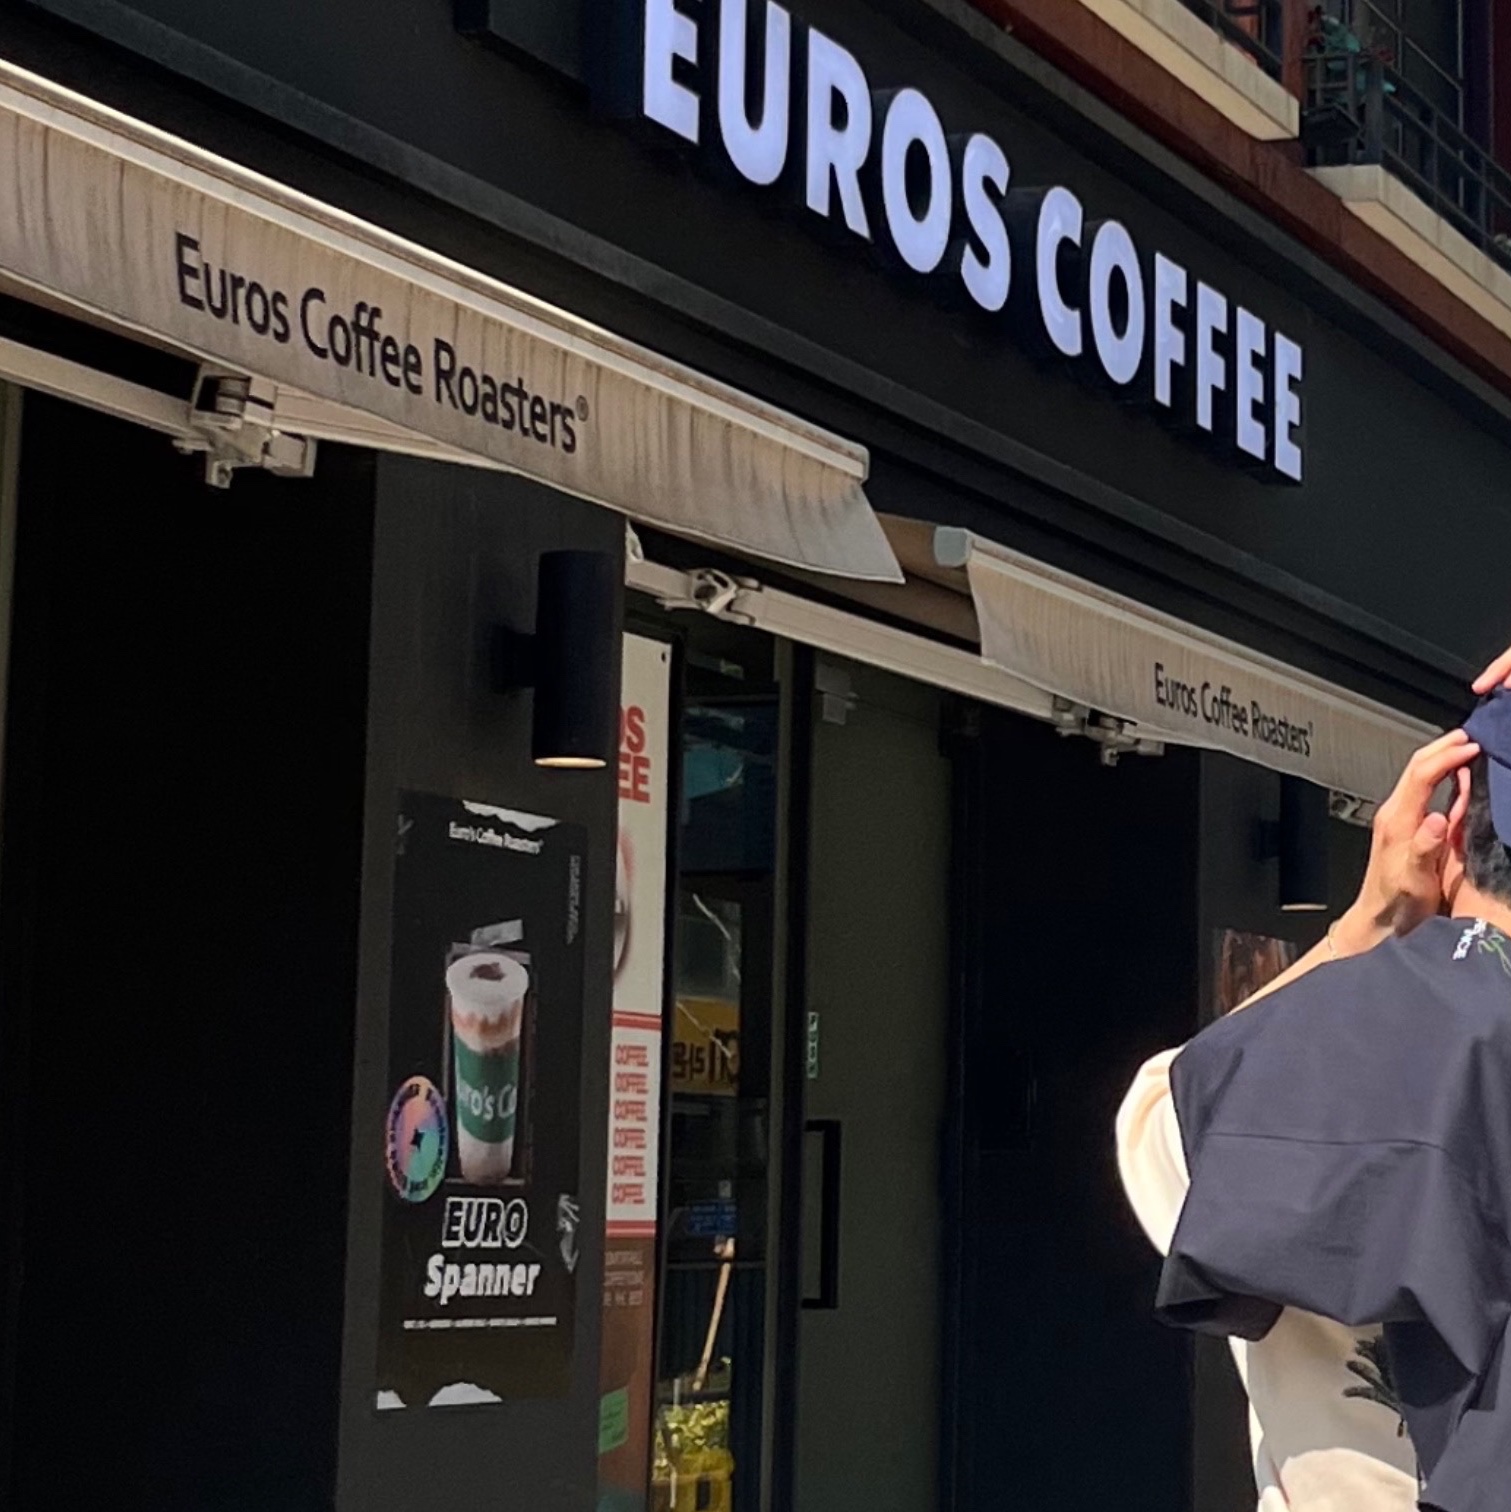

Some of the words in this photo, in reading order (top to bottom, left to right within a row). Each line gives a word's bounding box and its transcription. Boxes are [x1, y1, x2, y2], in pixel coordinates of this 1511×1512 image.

[643, 0, 1012, 311] EUROS
[1035, 186, 1302, 482] COFFEE
[175, 231, 291, 344] Euros
[300, 287, 424, 396] Coffee
[1155, 662, 1198, 718] Euros
[1201, 681, 1249, 737] Coffee
[620, 705, 646, 754] S
[618, 752, 651, 804] EE
[441, 1196, 529, 1249] EURO
[423, 1253, 542, 1306] Spanner
